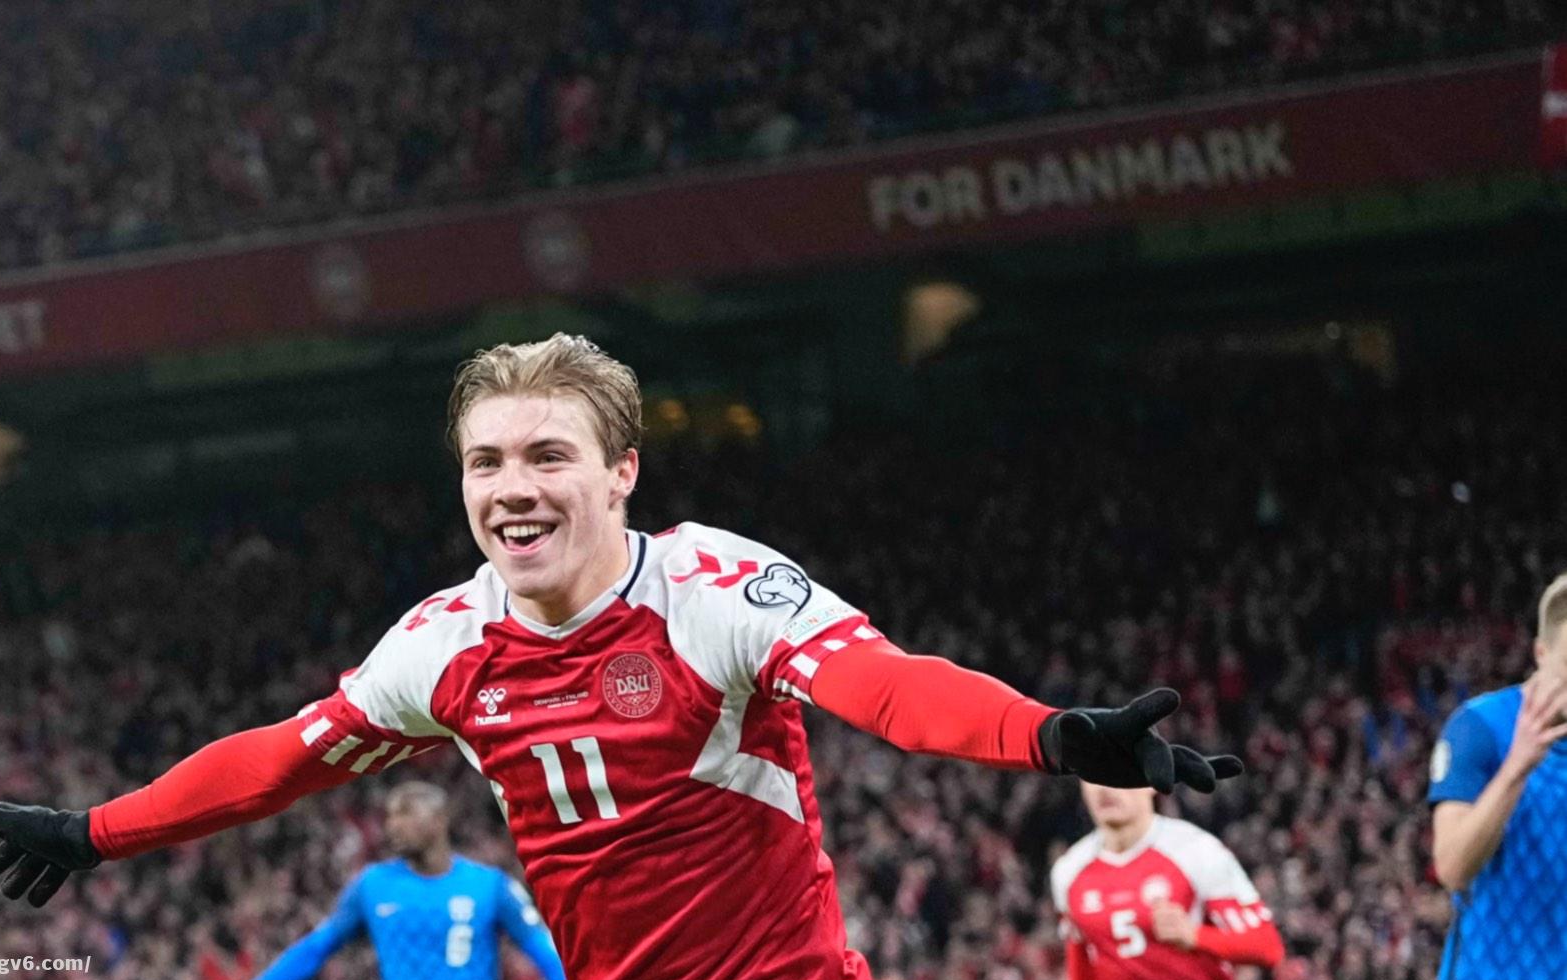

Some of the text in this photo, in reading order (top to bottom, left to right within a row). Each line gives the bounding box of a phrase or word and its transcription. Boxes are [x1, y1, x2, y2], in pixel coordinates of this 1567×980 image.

[869, 119, 1293, 232] FOR DANMARK
[615, 674, 650, 696] DBU
[475, 712, 512, 726] hummel
[530, 736, 620, 824] 11
[445, 923, 474, 968] 6
[1110, 909, 1147, 958] 5
